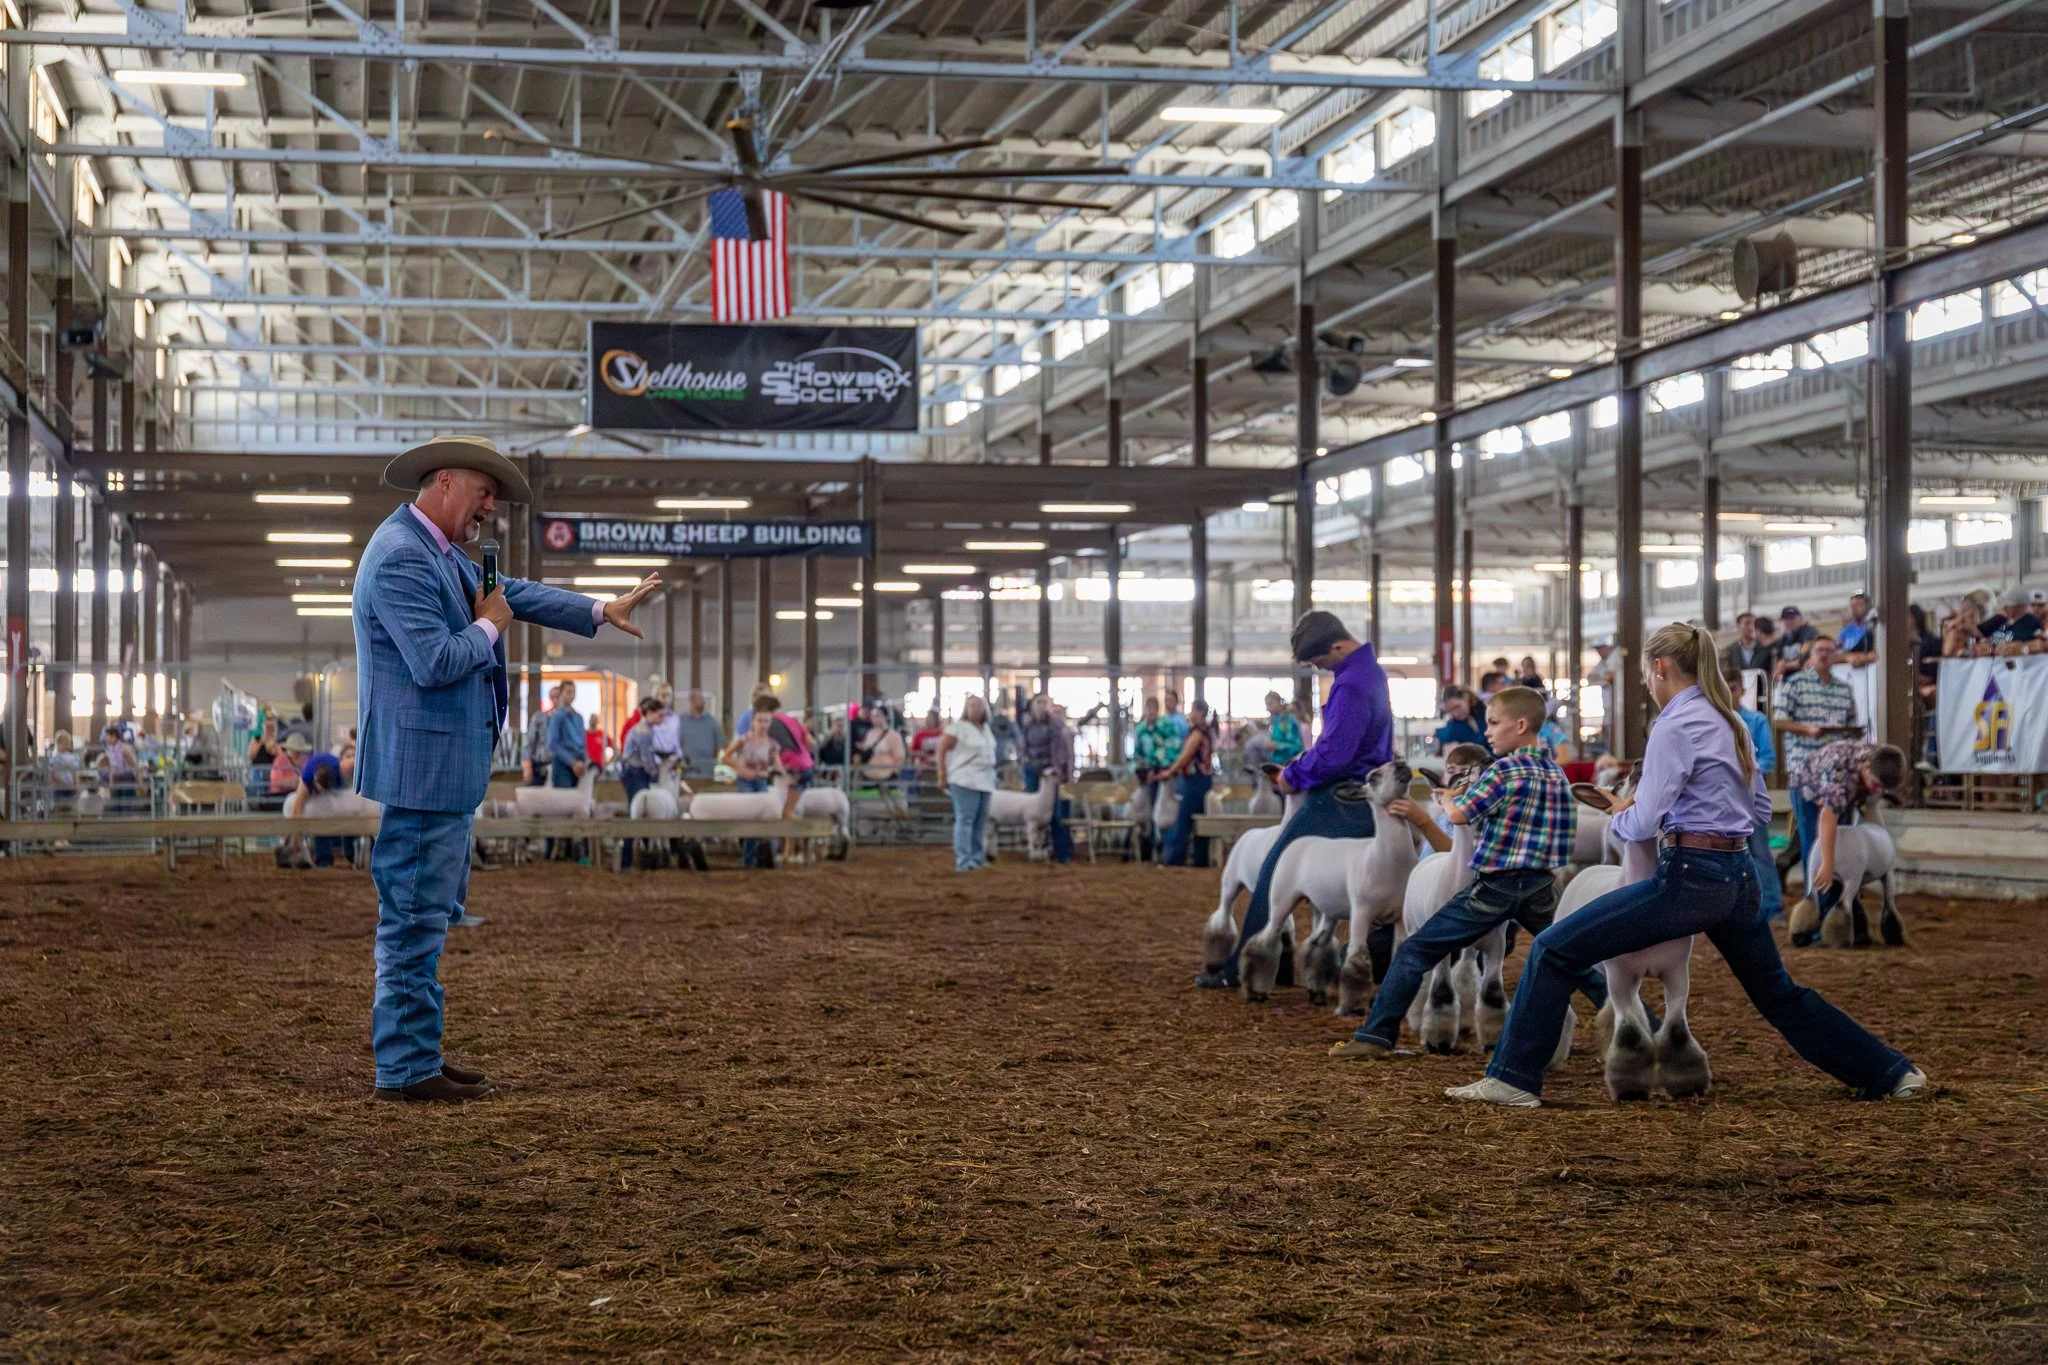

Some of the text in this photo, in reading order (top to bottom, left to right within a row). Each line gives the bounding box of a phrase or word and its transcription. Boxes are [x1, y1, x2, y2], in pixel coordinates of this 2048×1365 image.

[608, 354, 748, 391] Shellhouse
[774, 361, 815, 372] THE
[760, 368, 912, 395] SHOWBOX
[774, 388, 899, 405] SOCIETY
[580, 522, 862, 544] BROWN SHEEP BUILDING
